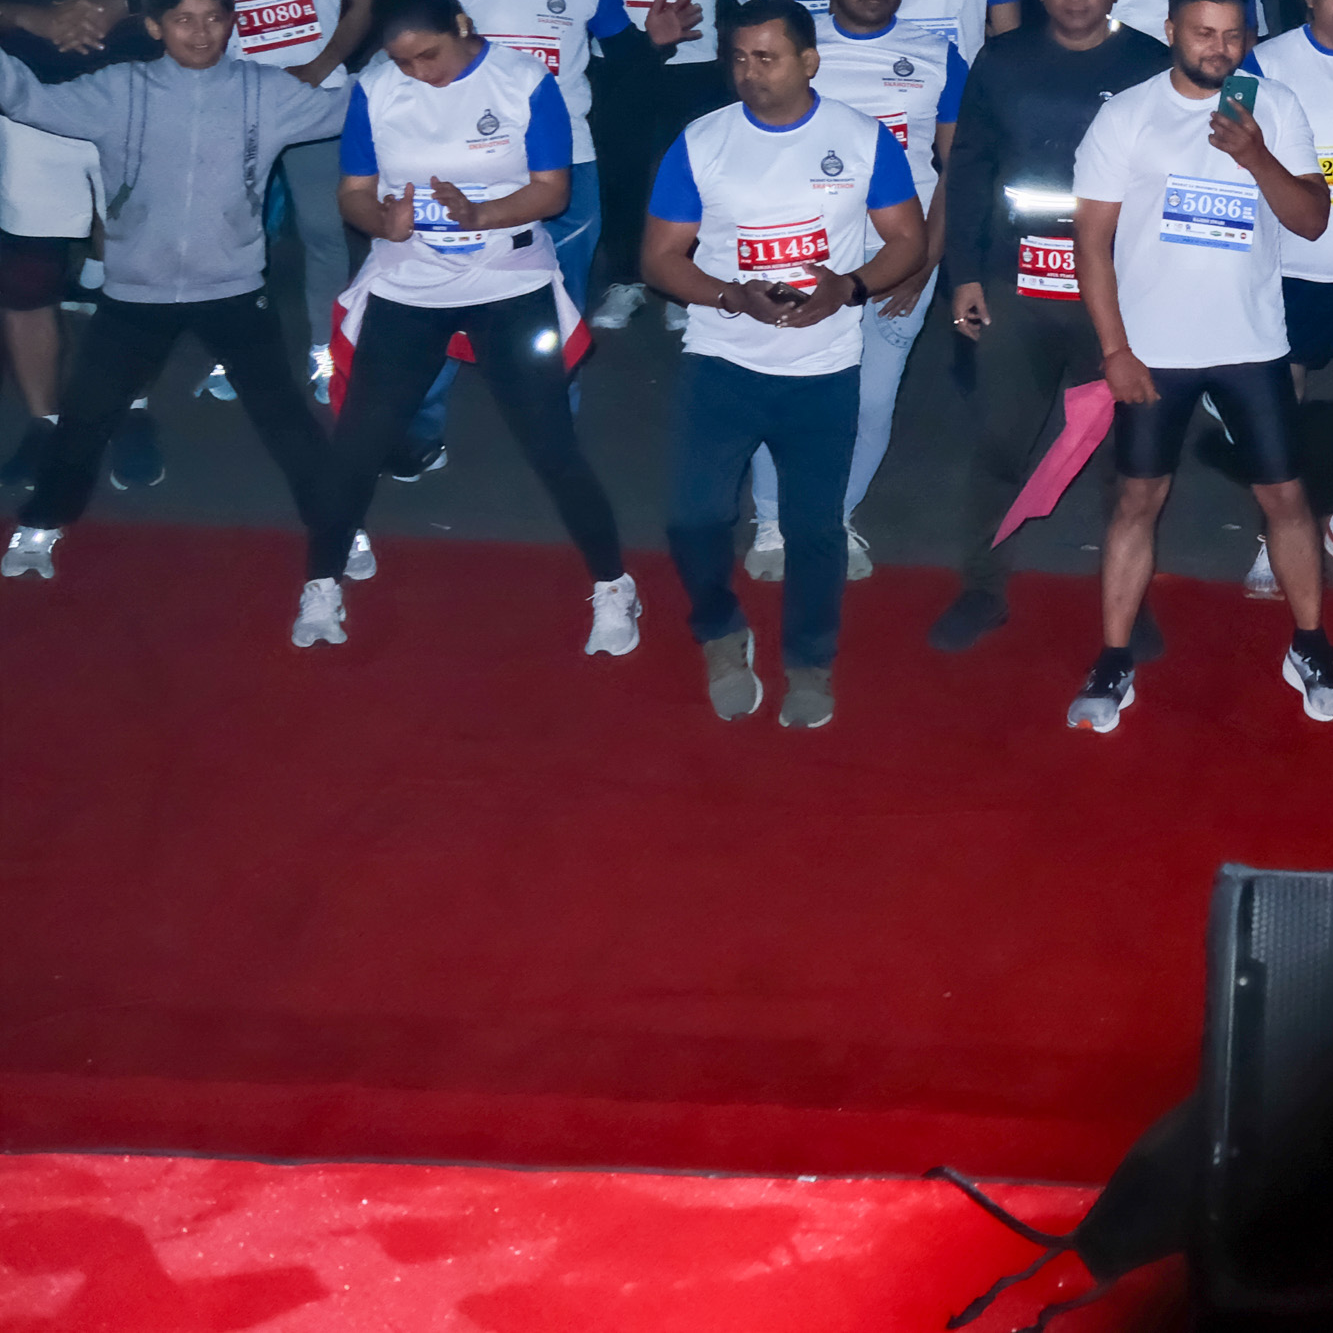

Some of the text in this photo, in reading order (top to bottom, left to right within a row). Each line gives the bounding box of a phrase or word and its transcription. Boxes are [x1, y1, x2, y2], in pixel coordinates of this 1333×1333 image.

[250, 2, 302, 27] 1080
[1182, 192, 1242, 218] 5086
[753, 235, 816, 262] 1145
[1035, 250, 1076, 271] 103
